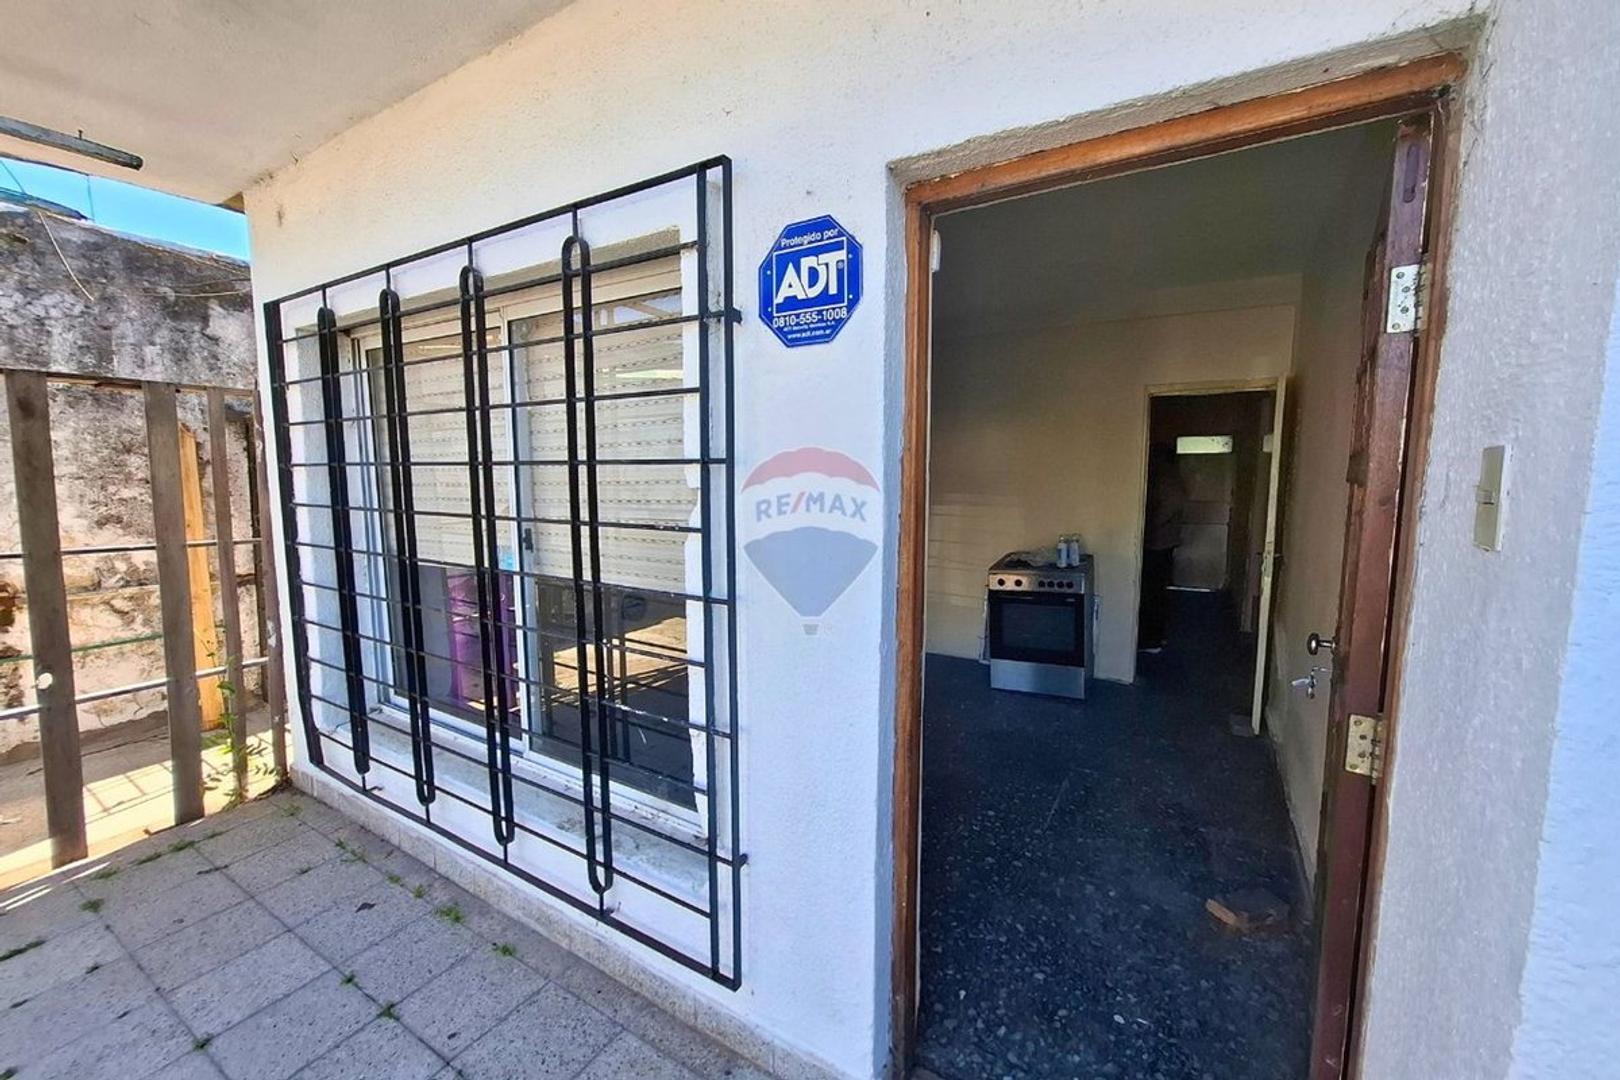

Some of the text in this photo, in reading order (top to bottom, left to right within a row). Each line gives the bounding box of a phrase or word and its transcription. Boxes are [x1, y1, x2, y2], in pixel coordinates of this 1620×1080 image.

[781, 228, 839, 248] Protegido por
[775, 249, 845, 304] ADT
[773, 307, 848, 328] 0810-555-1008
